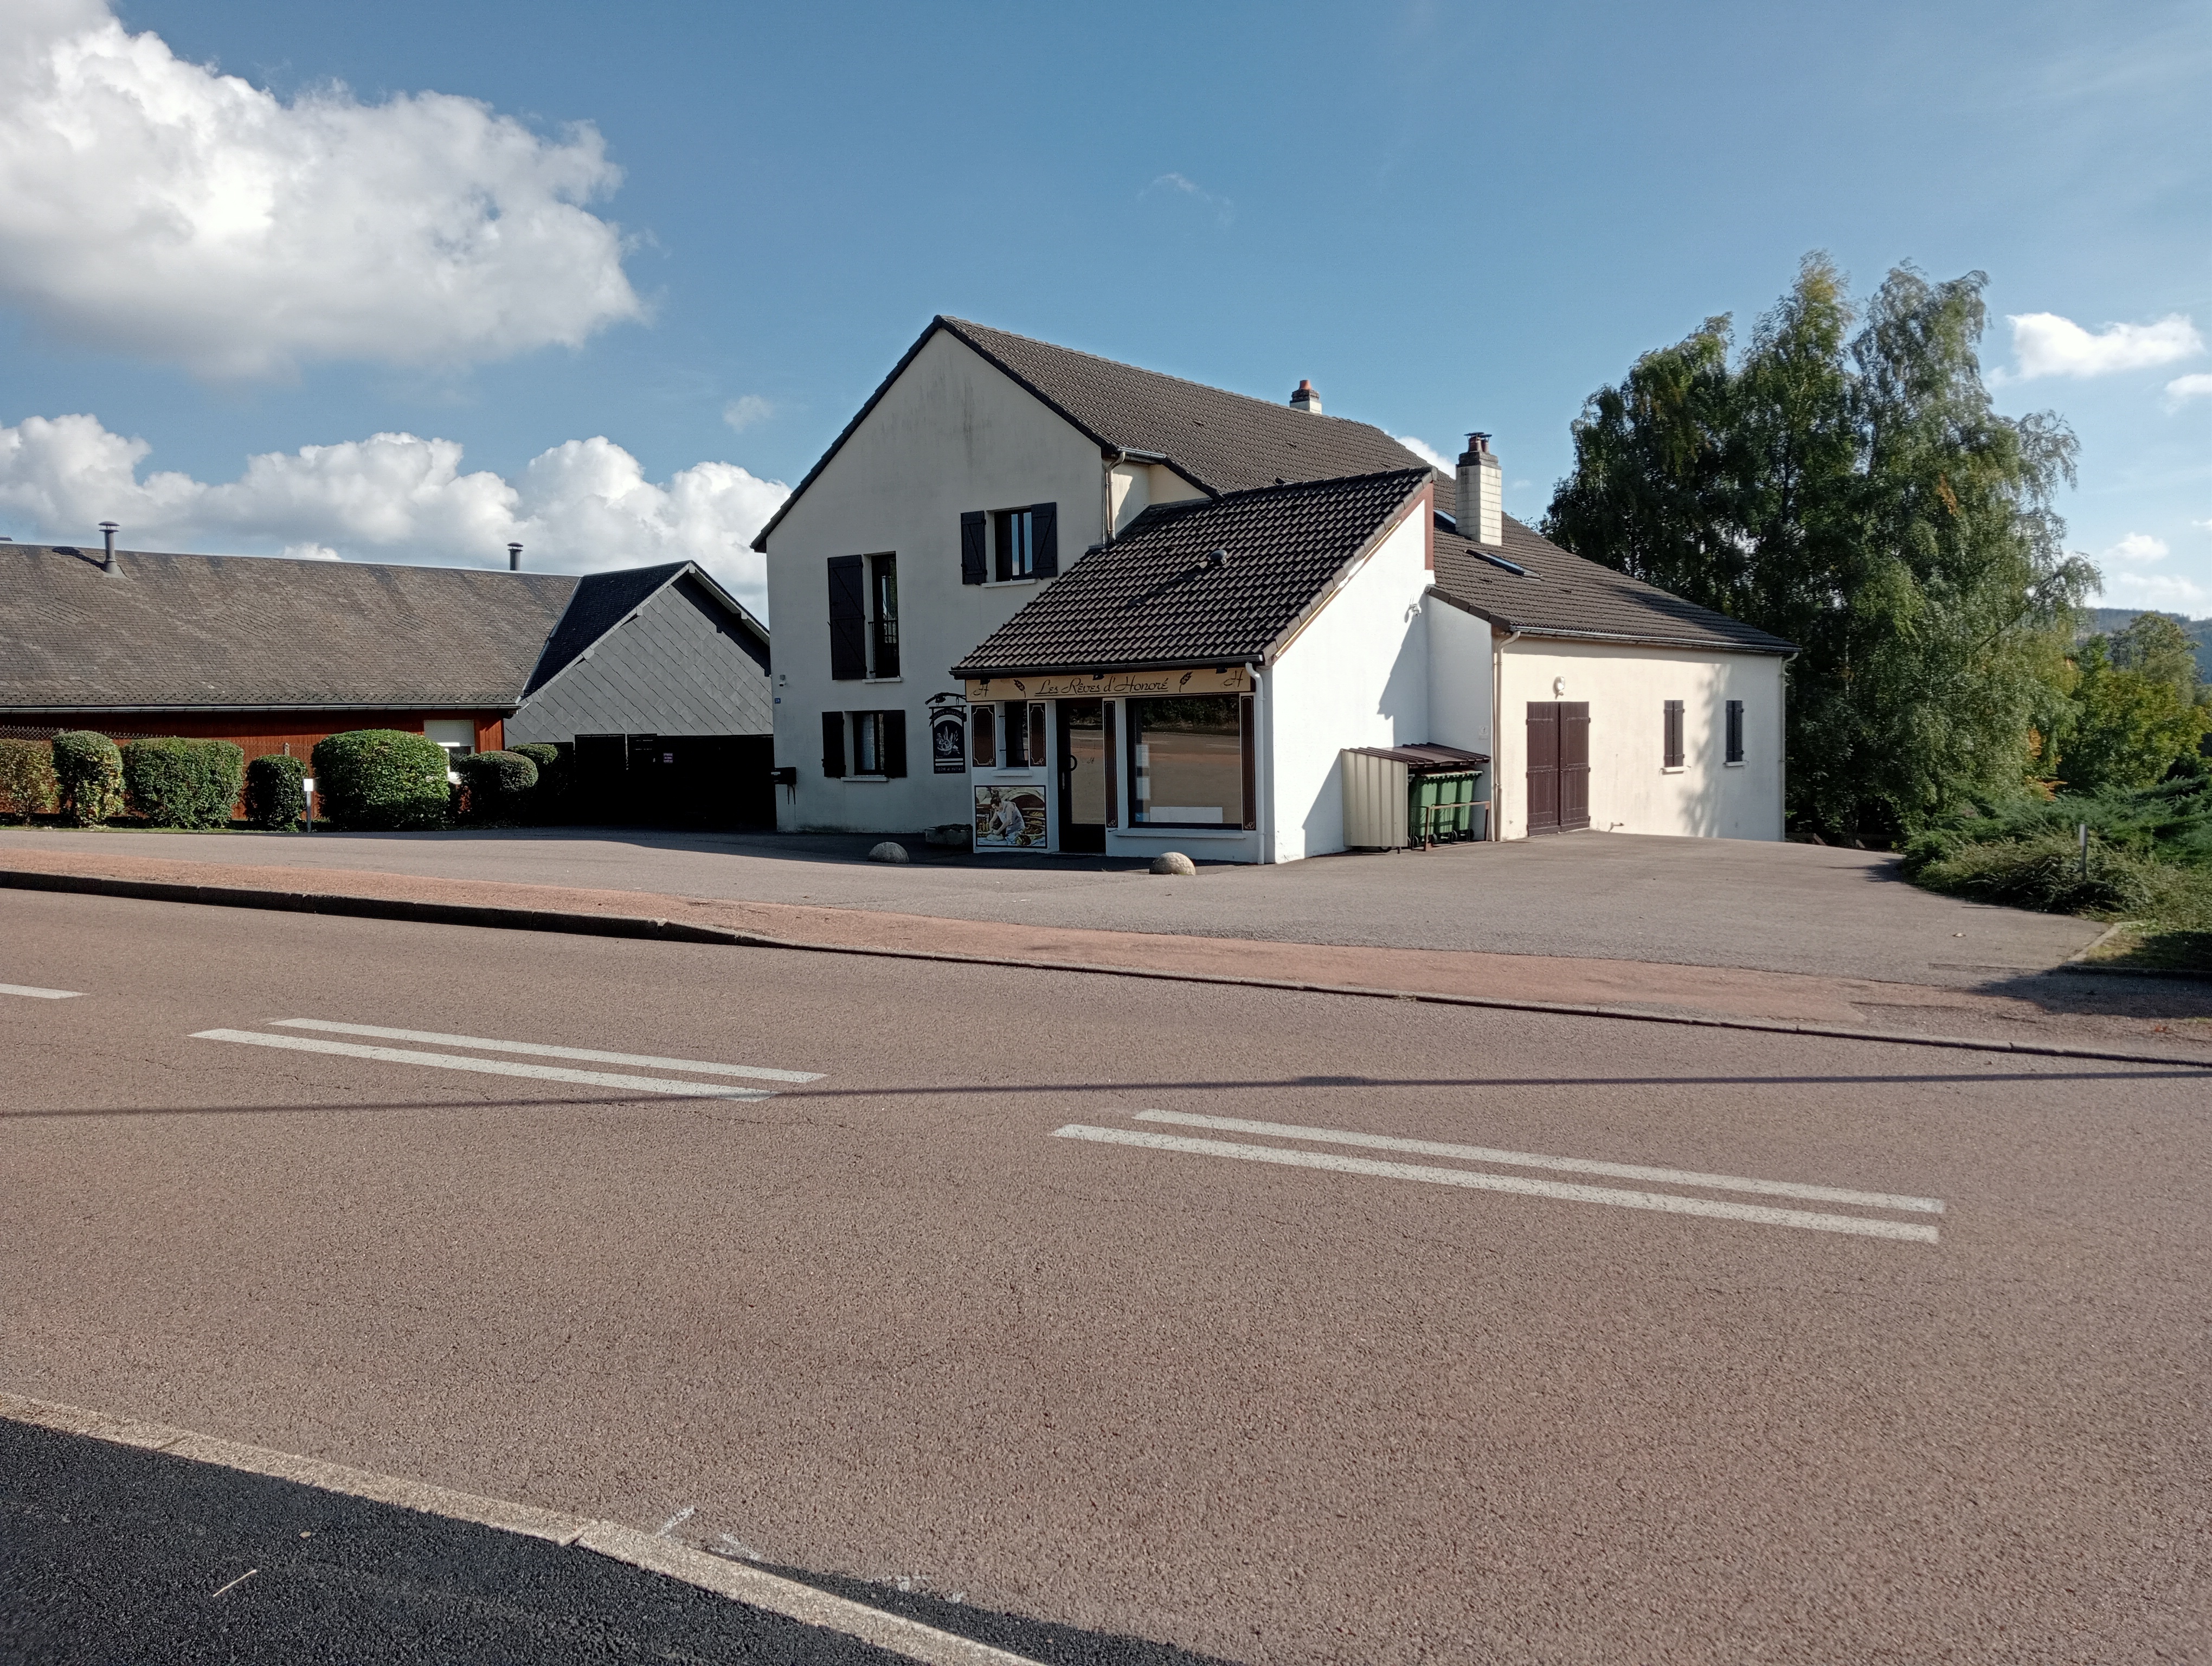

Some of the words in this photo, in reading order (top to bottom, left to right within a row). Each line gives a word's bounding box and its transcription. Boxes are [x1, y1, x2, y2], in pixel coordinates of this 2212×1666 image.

[1035, 679, 1058, 695] Les
[1061, 677, 1101, 695] Rêves
[1103, 675, 1169, 693] d'Honoré
